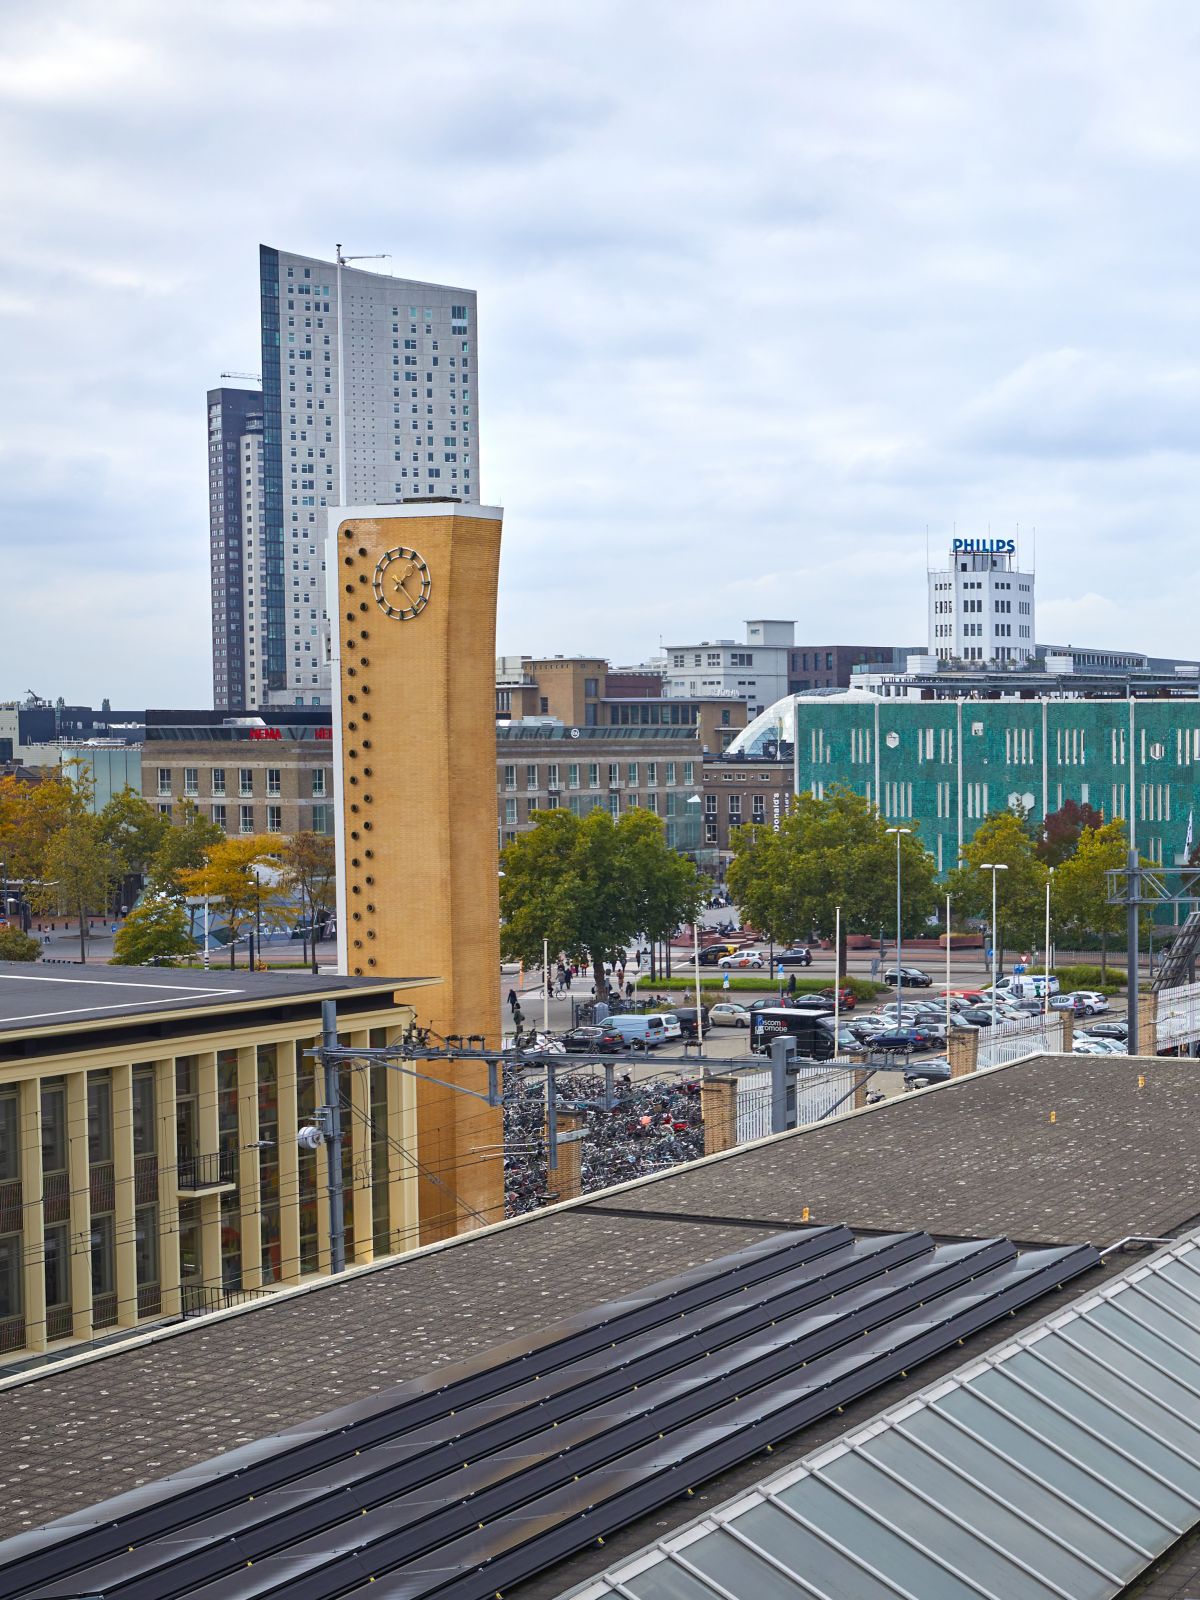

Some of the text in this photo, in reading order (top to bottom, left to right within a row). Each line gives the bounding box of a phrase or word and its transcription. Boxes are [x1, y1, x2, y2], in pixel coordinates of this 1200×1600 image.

[953, 538, 1015, 554] PHILIPS
[249, 727, 282, 740] HEMA
[315, 727, 332, 740] HE
[772, 792, 780, 833] Donald's
